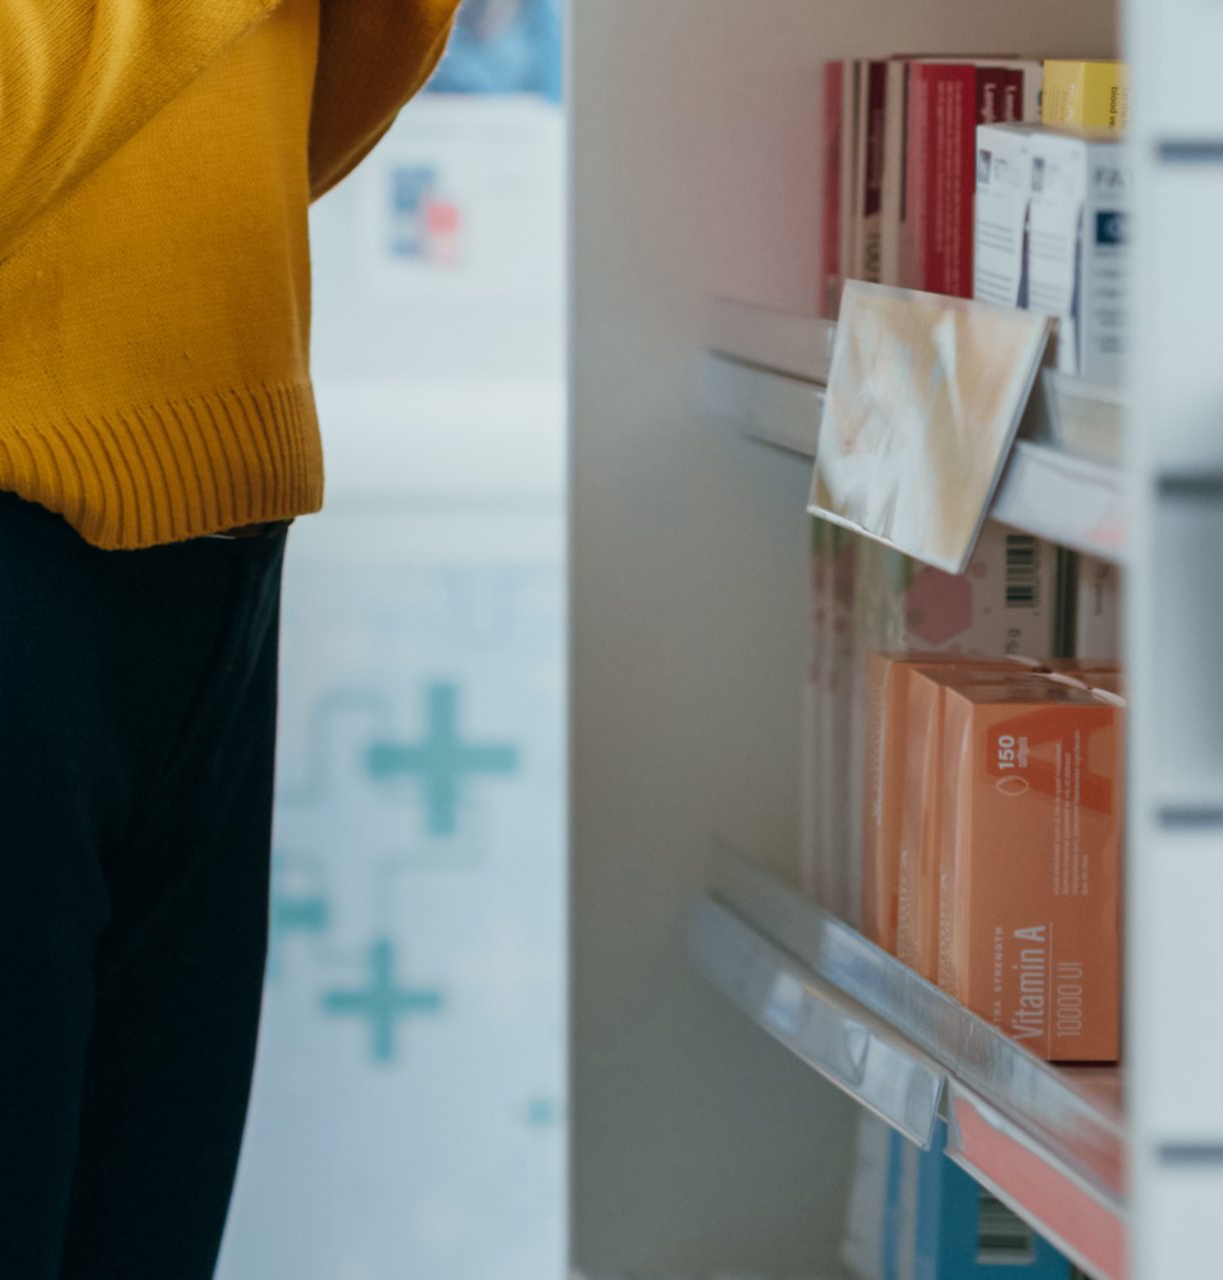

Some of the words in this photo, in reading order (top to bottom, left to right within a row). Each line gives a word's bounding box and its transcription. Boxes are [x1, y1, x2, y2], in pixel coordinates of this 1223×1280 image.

[1109, 86, 1119, 114] blood
[997, 735, 1016, 770] 150
[1014, 924, 1046, 942] A
[993, 926, 1003, 991] STRENGTH
[1012, 944, 1045, 1040] Vitamin
[1056, 984, 1083, 1039] 10000
